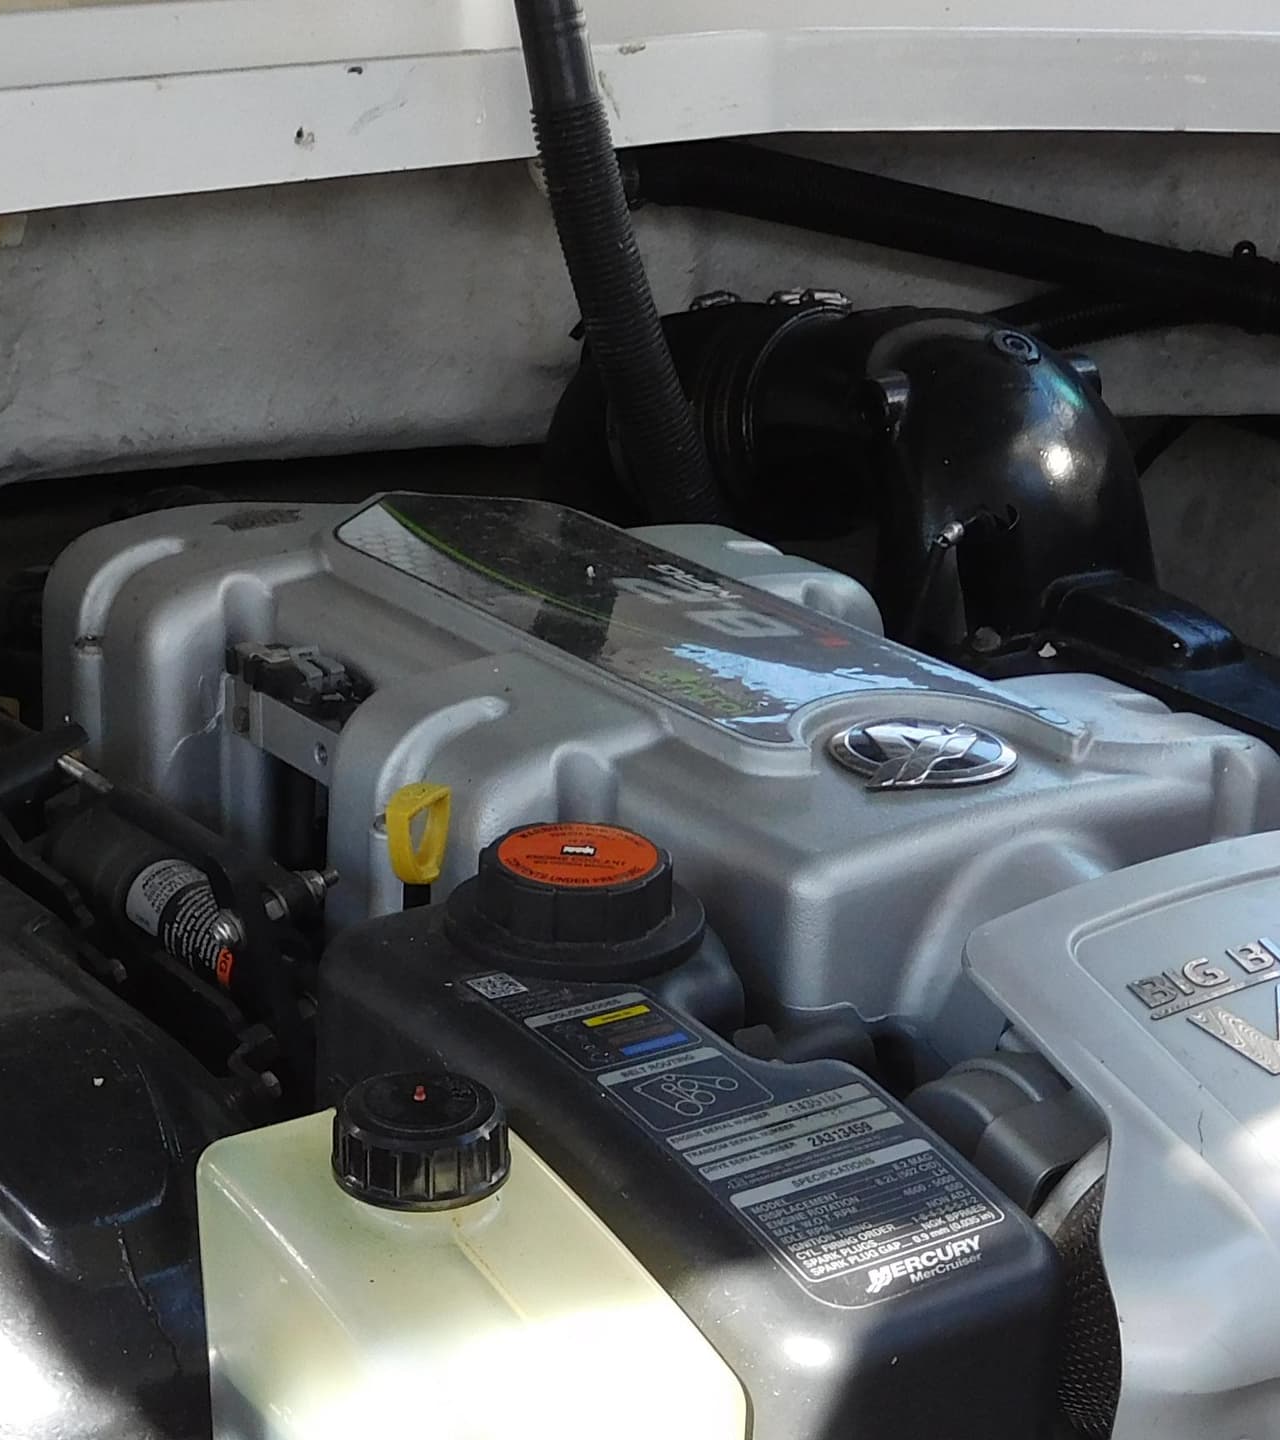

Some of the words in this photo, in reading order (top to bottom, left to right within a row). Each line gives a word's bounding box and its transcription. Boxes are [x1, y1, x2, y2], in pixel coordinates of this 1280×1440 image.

[1126, 957, 1230, 1010] BIG
[804, 1119, 875, 1149] 2A313459
[789, 1155, 878, 1188] SPECIFICATIONS
[748, 1197, 790, 1215] MODEL
[756, 1190, 842, 1223] DISPLACEMENT
[764, 1210, 809, 1230] ENGINE
[804, 1194, 861, 1217] ROTATION
[831, 1204, 860, 1218] RPM
[778, 1231, 807, 1245] IDLE
[805, 1223, 833, 1237] RPM
[786, 1231, 837, 1253] IGNITION
[834, 1220, 874, 1238] TIMING
[800, 1249, 842, 1269] SPARK
[838, 1237, 880, 1257] PLUGS
[918, 1216, 946, 1230] NGK
[819, 1234, 860, 1253] FIRING
[855, 1222, 898, 1241] ORDER
[807, 1257, 850, 1277] SPARK
[845, 1247, 881, 1264] PLUG
[875, 1239, 905, 1254] GAP
[909, 1231, 932, 1244] 0.9
[926, 1225, 952, 1238] mm
[864, 1235, 981, 1294] MERCURY
[910, 1252, 983, 1286] MerCruiser
